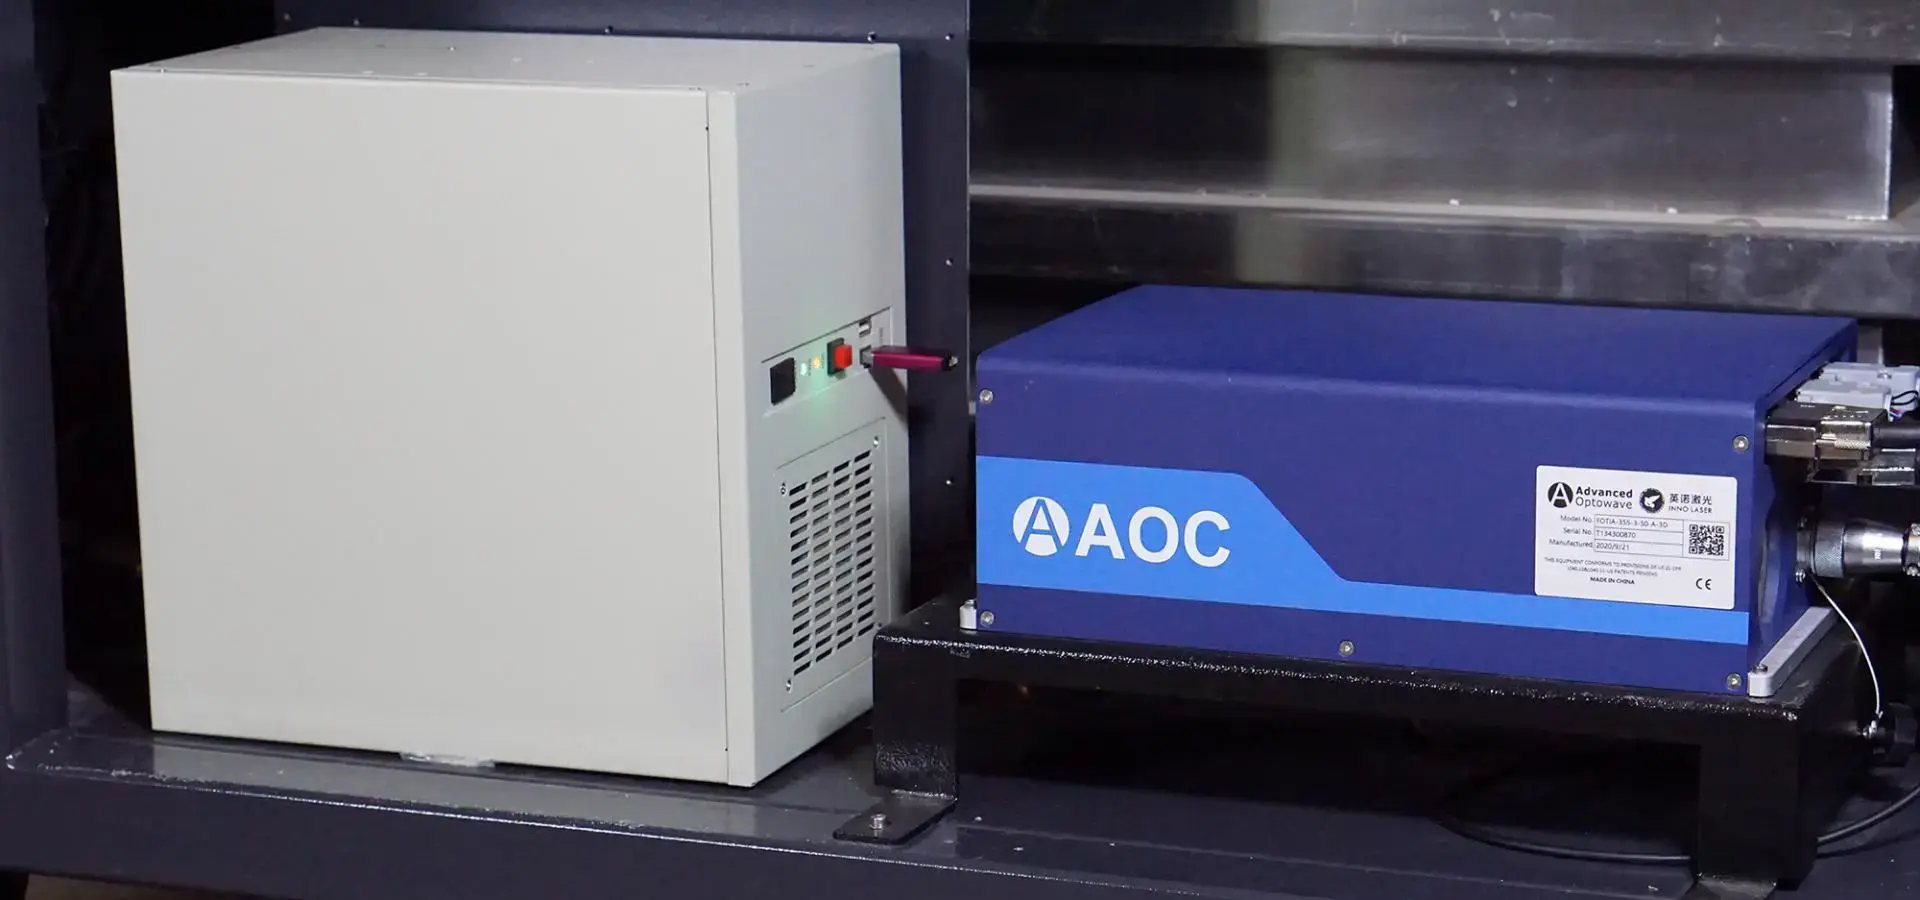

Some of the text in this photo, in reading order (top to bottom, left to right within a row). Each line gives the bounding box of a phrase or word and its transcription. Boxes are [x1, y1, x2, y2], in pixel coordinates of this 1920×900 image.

[1576, 486, 1633, 499] Advanced
[1575, 496, 1633, 509] Optowave
[1669, 493, 1712, 505] 英诺激光
[1560, 514, 1581, 522] Model
[1075, 503, 1231, 567] AOC
[1563, 526, 1580, 535] Serial
[1549, 538, 1593, 548] Manufactured
